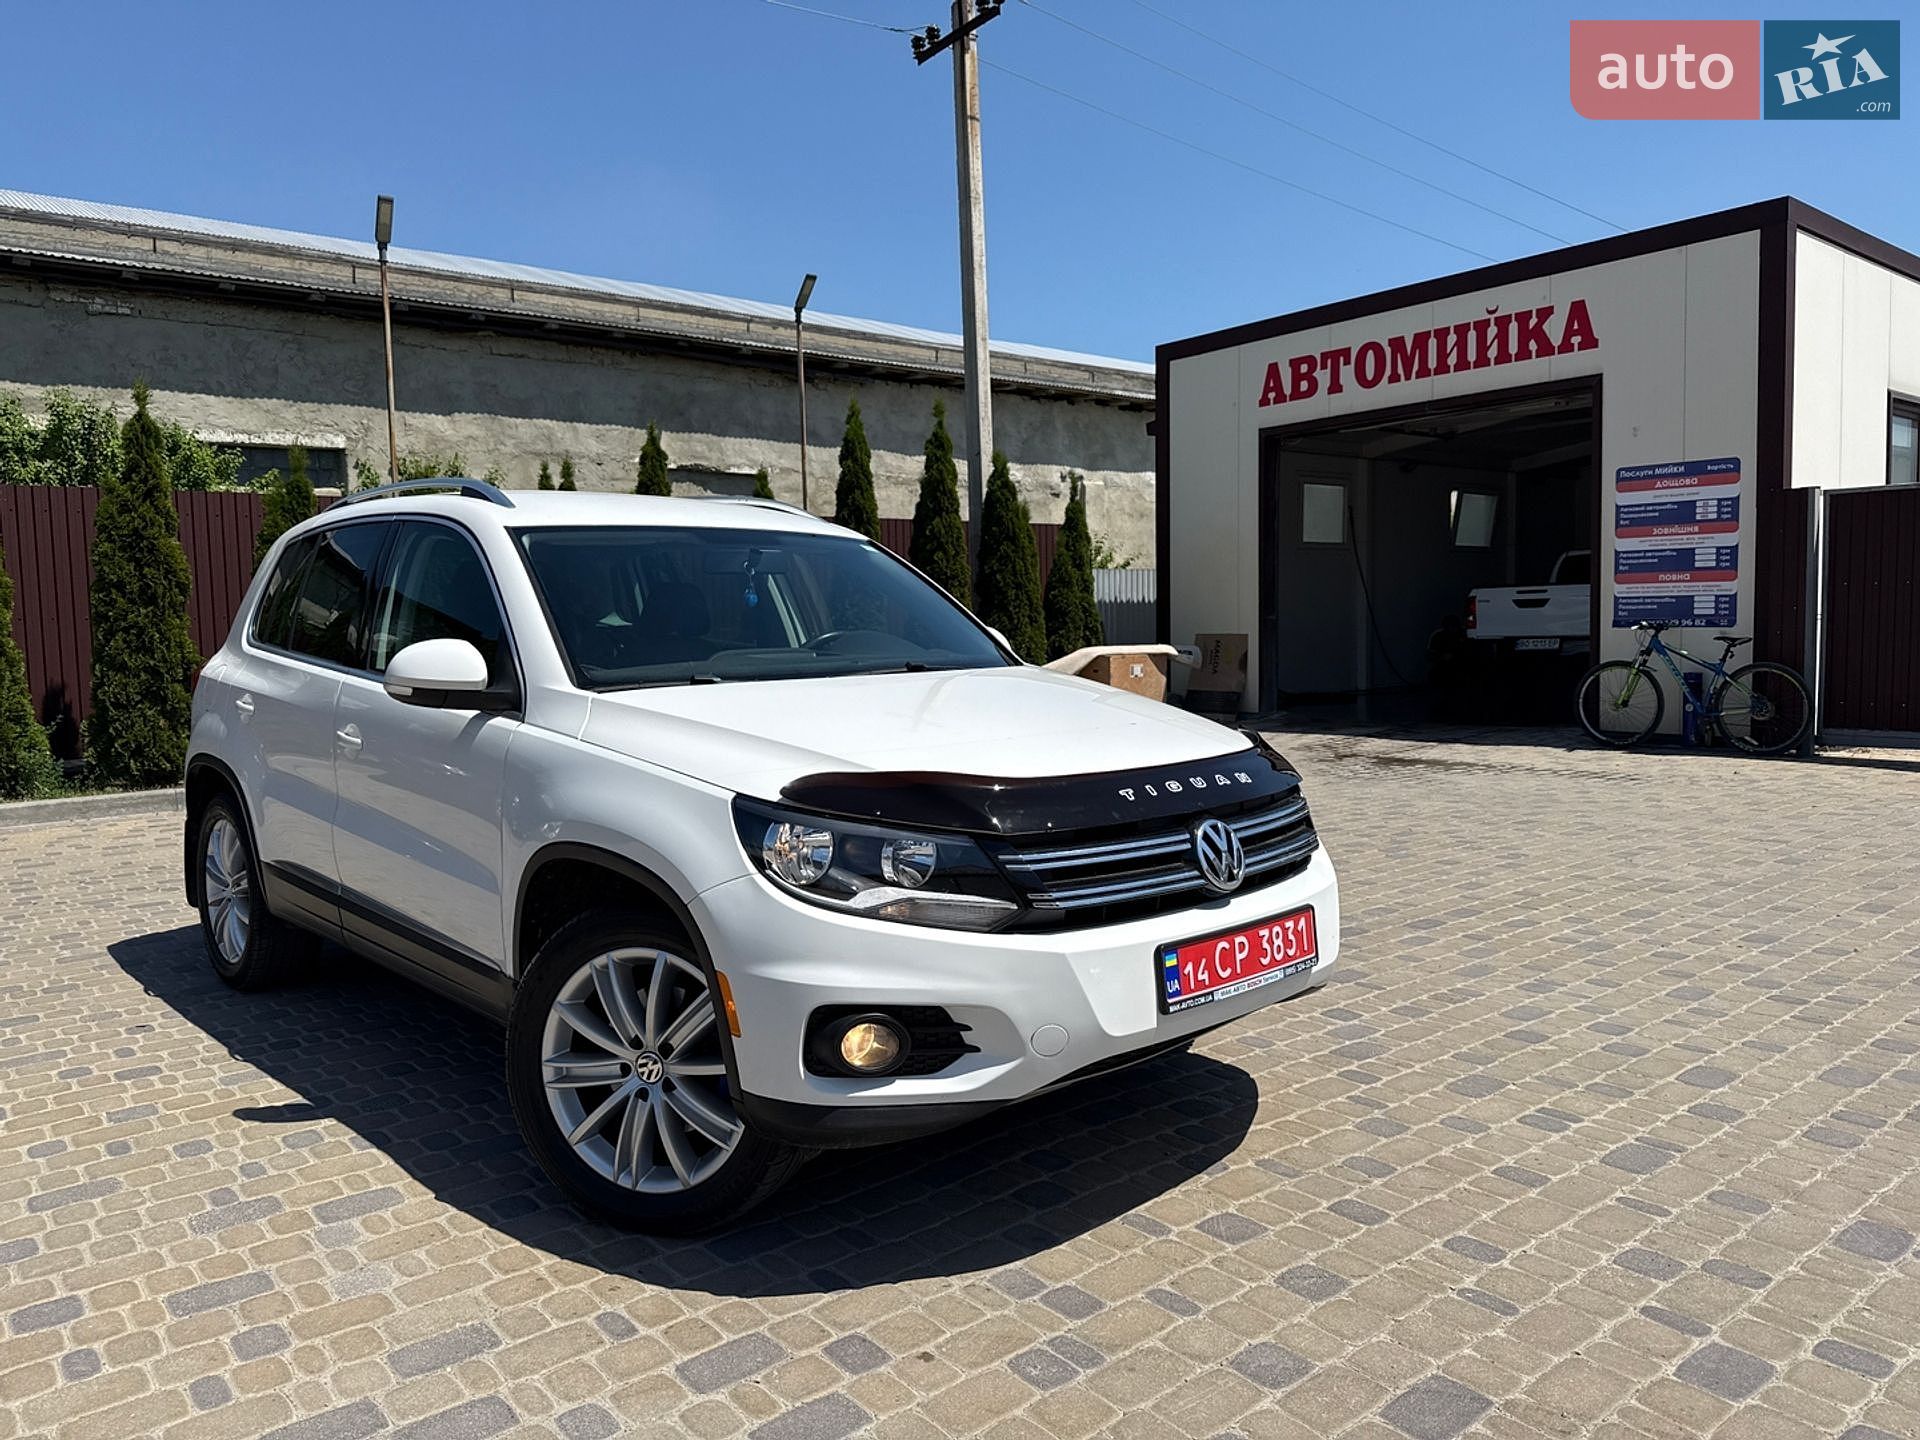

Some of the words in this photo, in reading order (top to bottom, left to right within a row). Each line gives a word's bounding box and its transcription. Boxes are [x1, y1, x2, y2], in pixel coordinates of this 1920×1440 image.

[1258, 299, 1599, 408] АВТОМИЙКА
[1118, 772, 1252, 801] TIGUAN
[1183, 958, 1209, 990] 14
[1214, 935, 1249, 979] CP
[1258, 917, 1309, 966] 3831
[1167, 979, 1180, 993] UA
